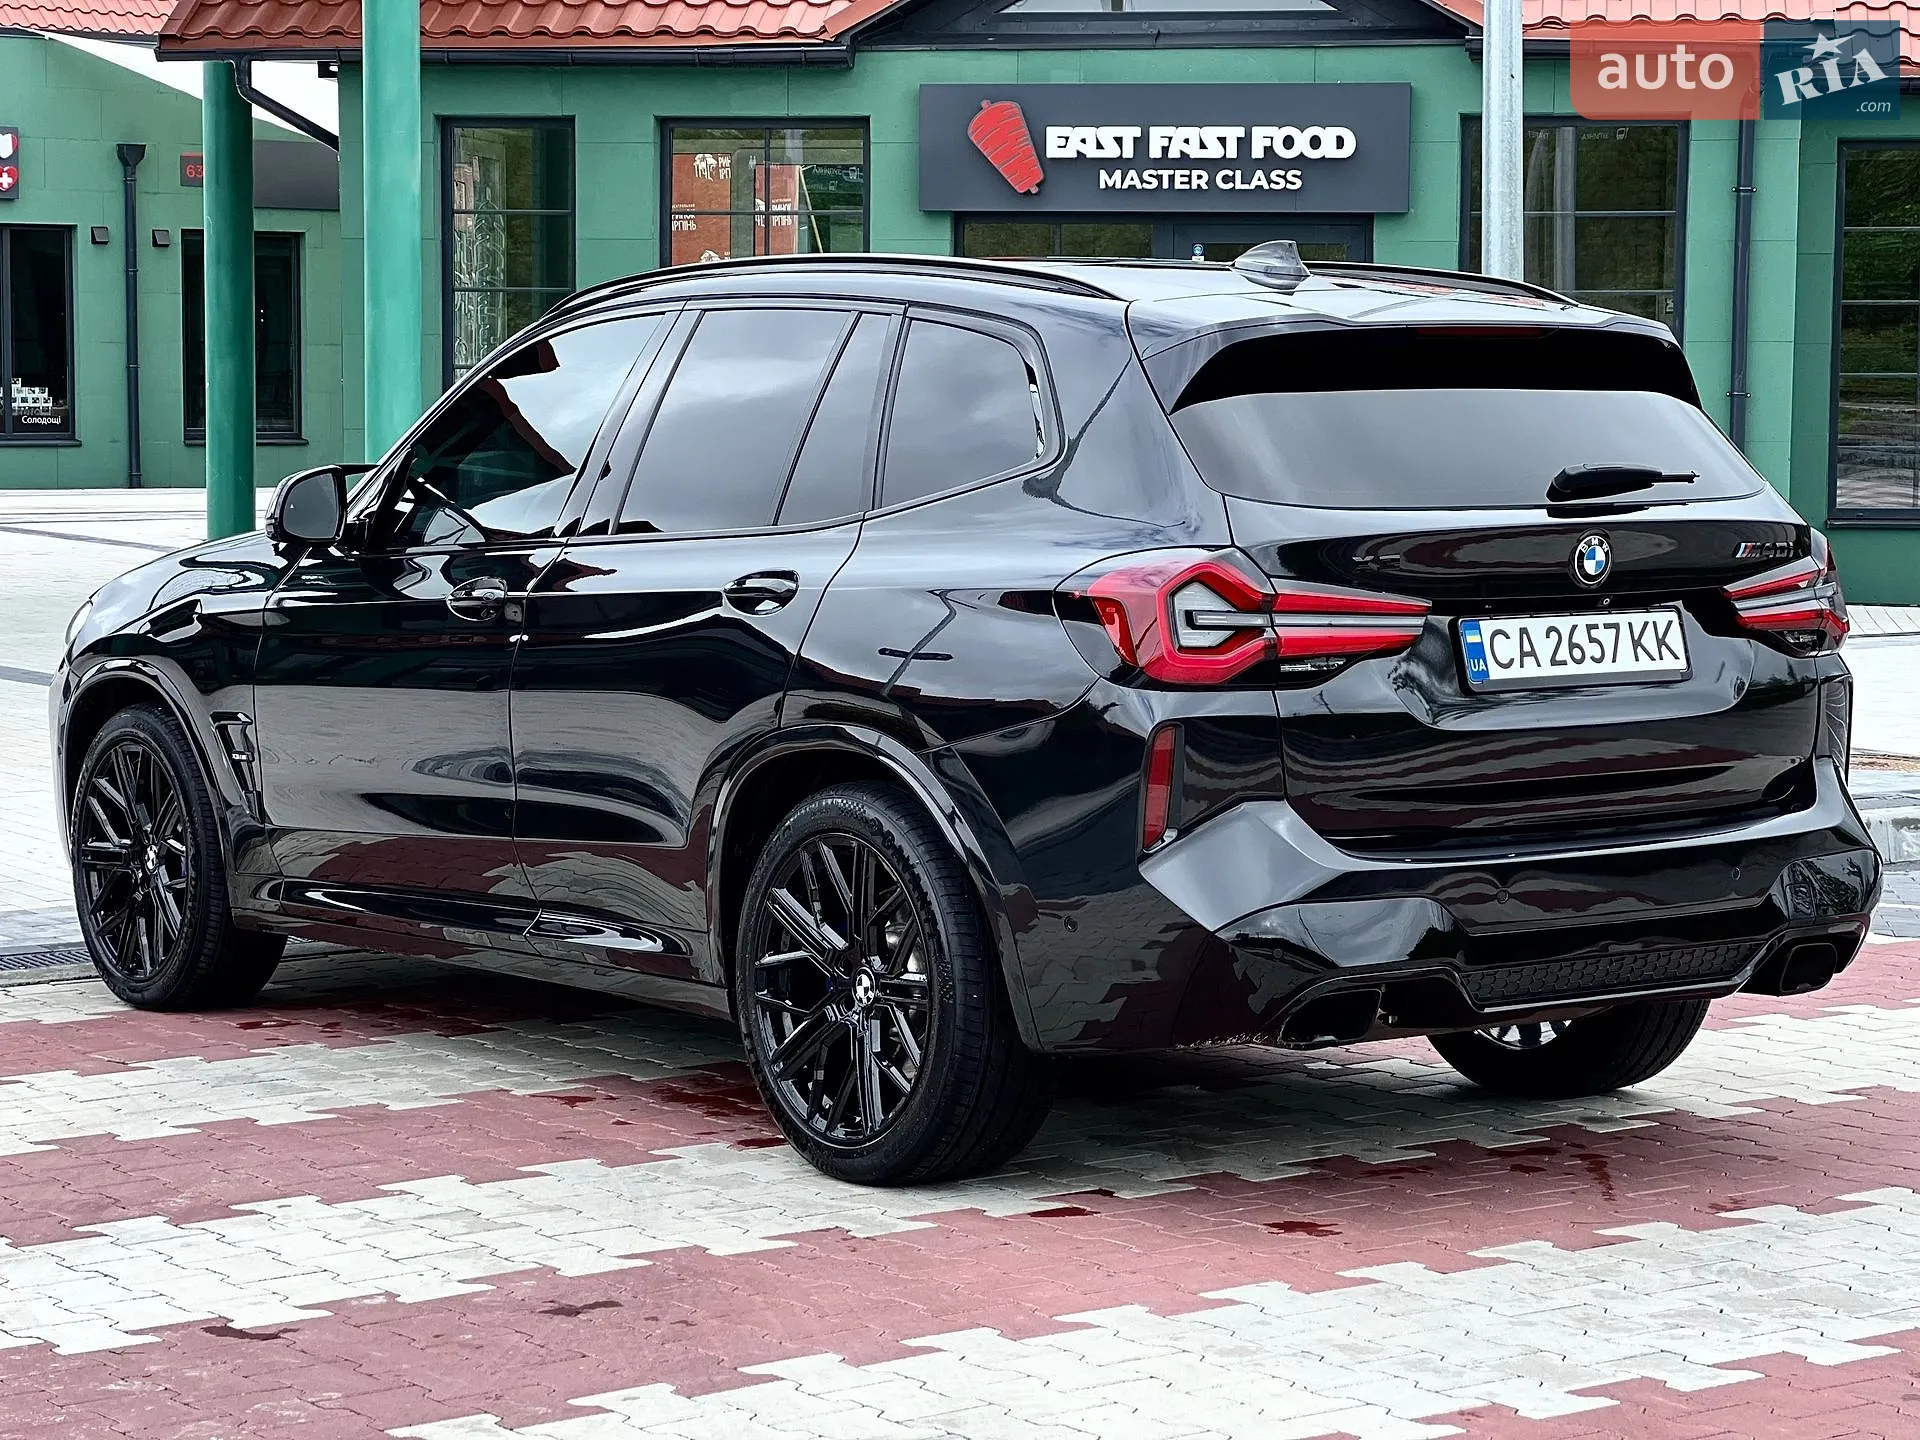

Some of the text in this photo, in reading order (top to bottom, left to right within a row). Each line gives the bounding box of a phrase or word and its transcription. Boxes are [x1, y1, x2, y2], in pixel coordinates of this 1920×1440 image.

[1045, 125, 1358, 159] EAST FAST FOOD
[1099, 169, 1303, 190] MASTER CLASS
[21, 415, 62, 425] Солодощі
[1580, 537, 1610, 554] BMW
[1489, 619, 1681, 669] CA 2657 KK
[1470, 658, 1487, 672] UA
